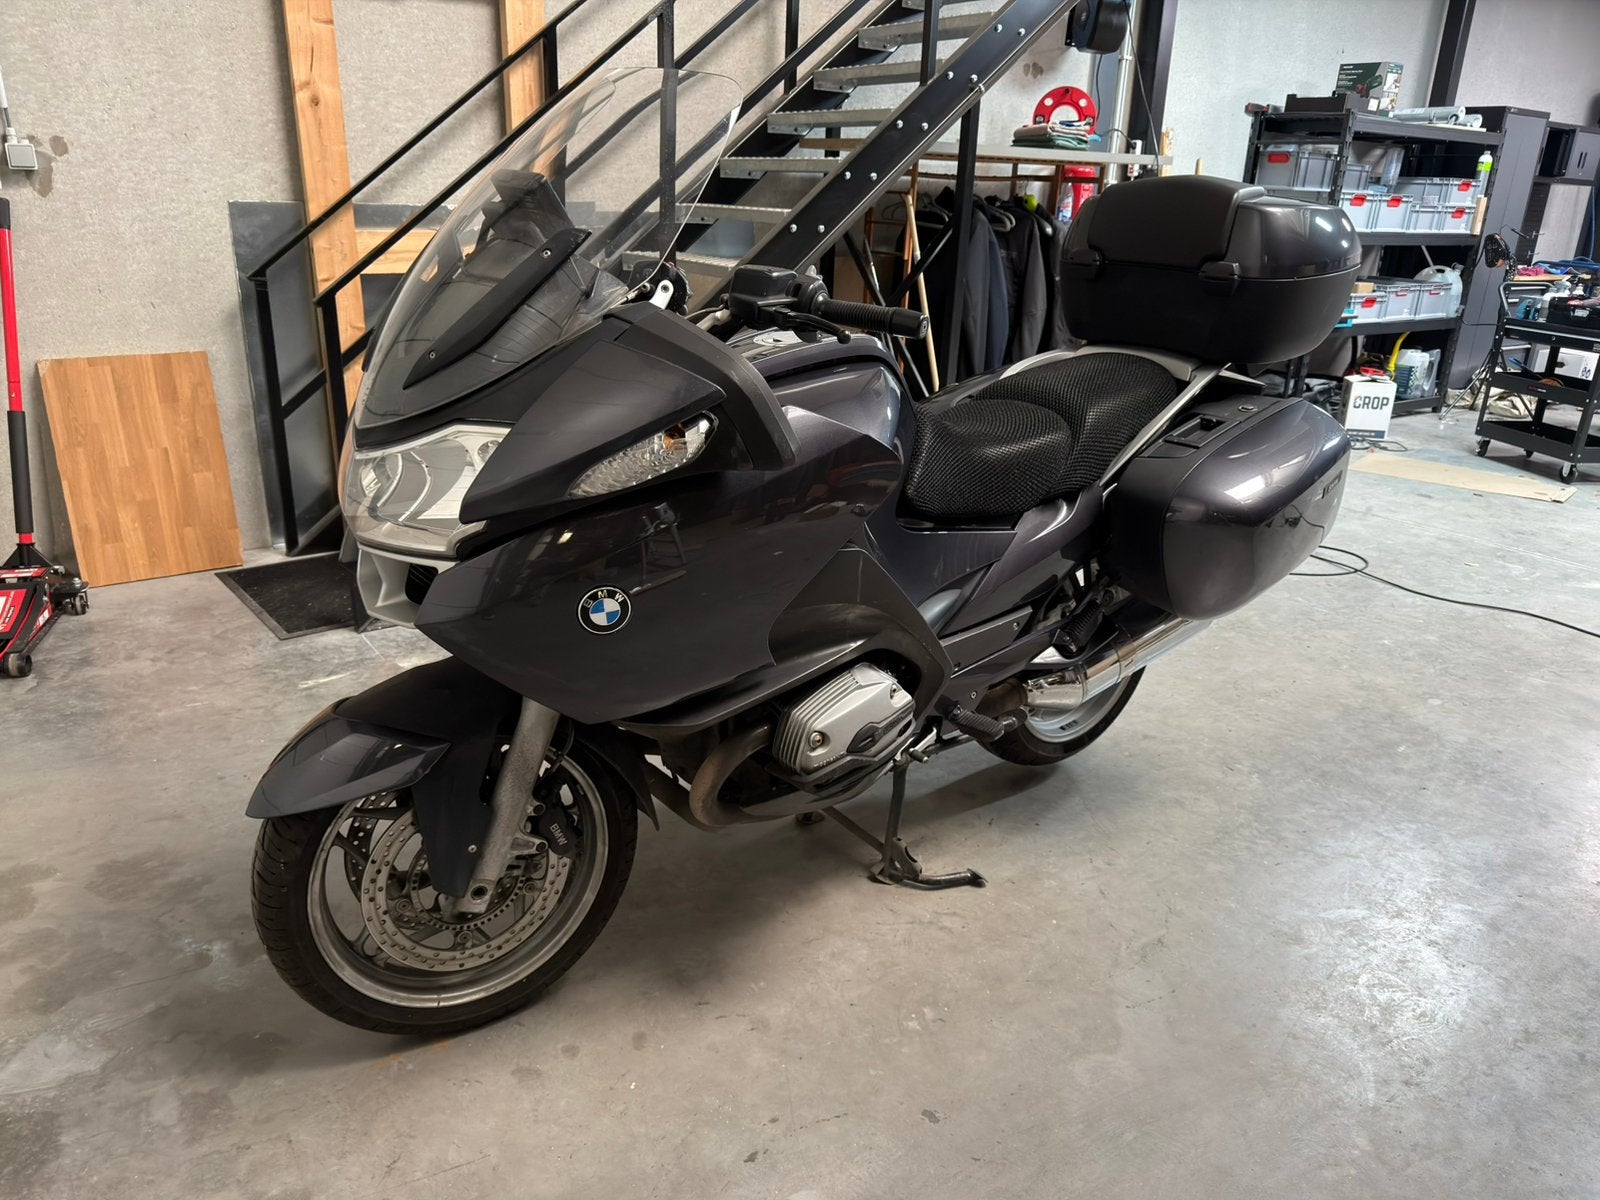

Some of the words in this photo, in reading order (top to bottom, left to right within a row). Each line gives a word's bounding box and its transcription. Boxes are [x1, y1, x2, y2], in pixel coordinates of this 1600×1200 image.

[1353, 395, 1390, 410] CROP
[583, 589, 625, 608] BMW
[550, 823, 568, 846] BMW
